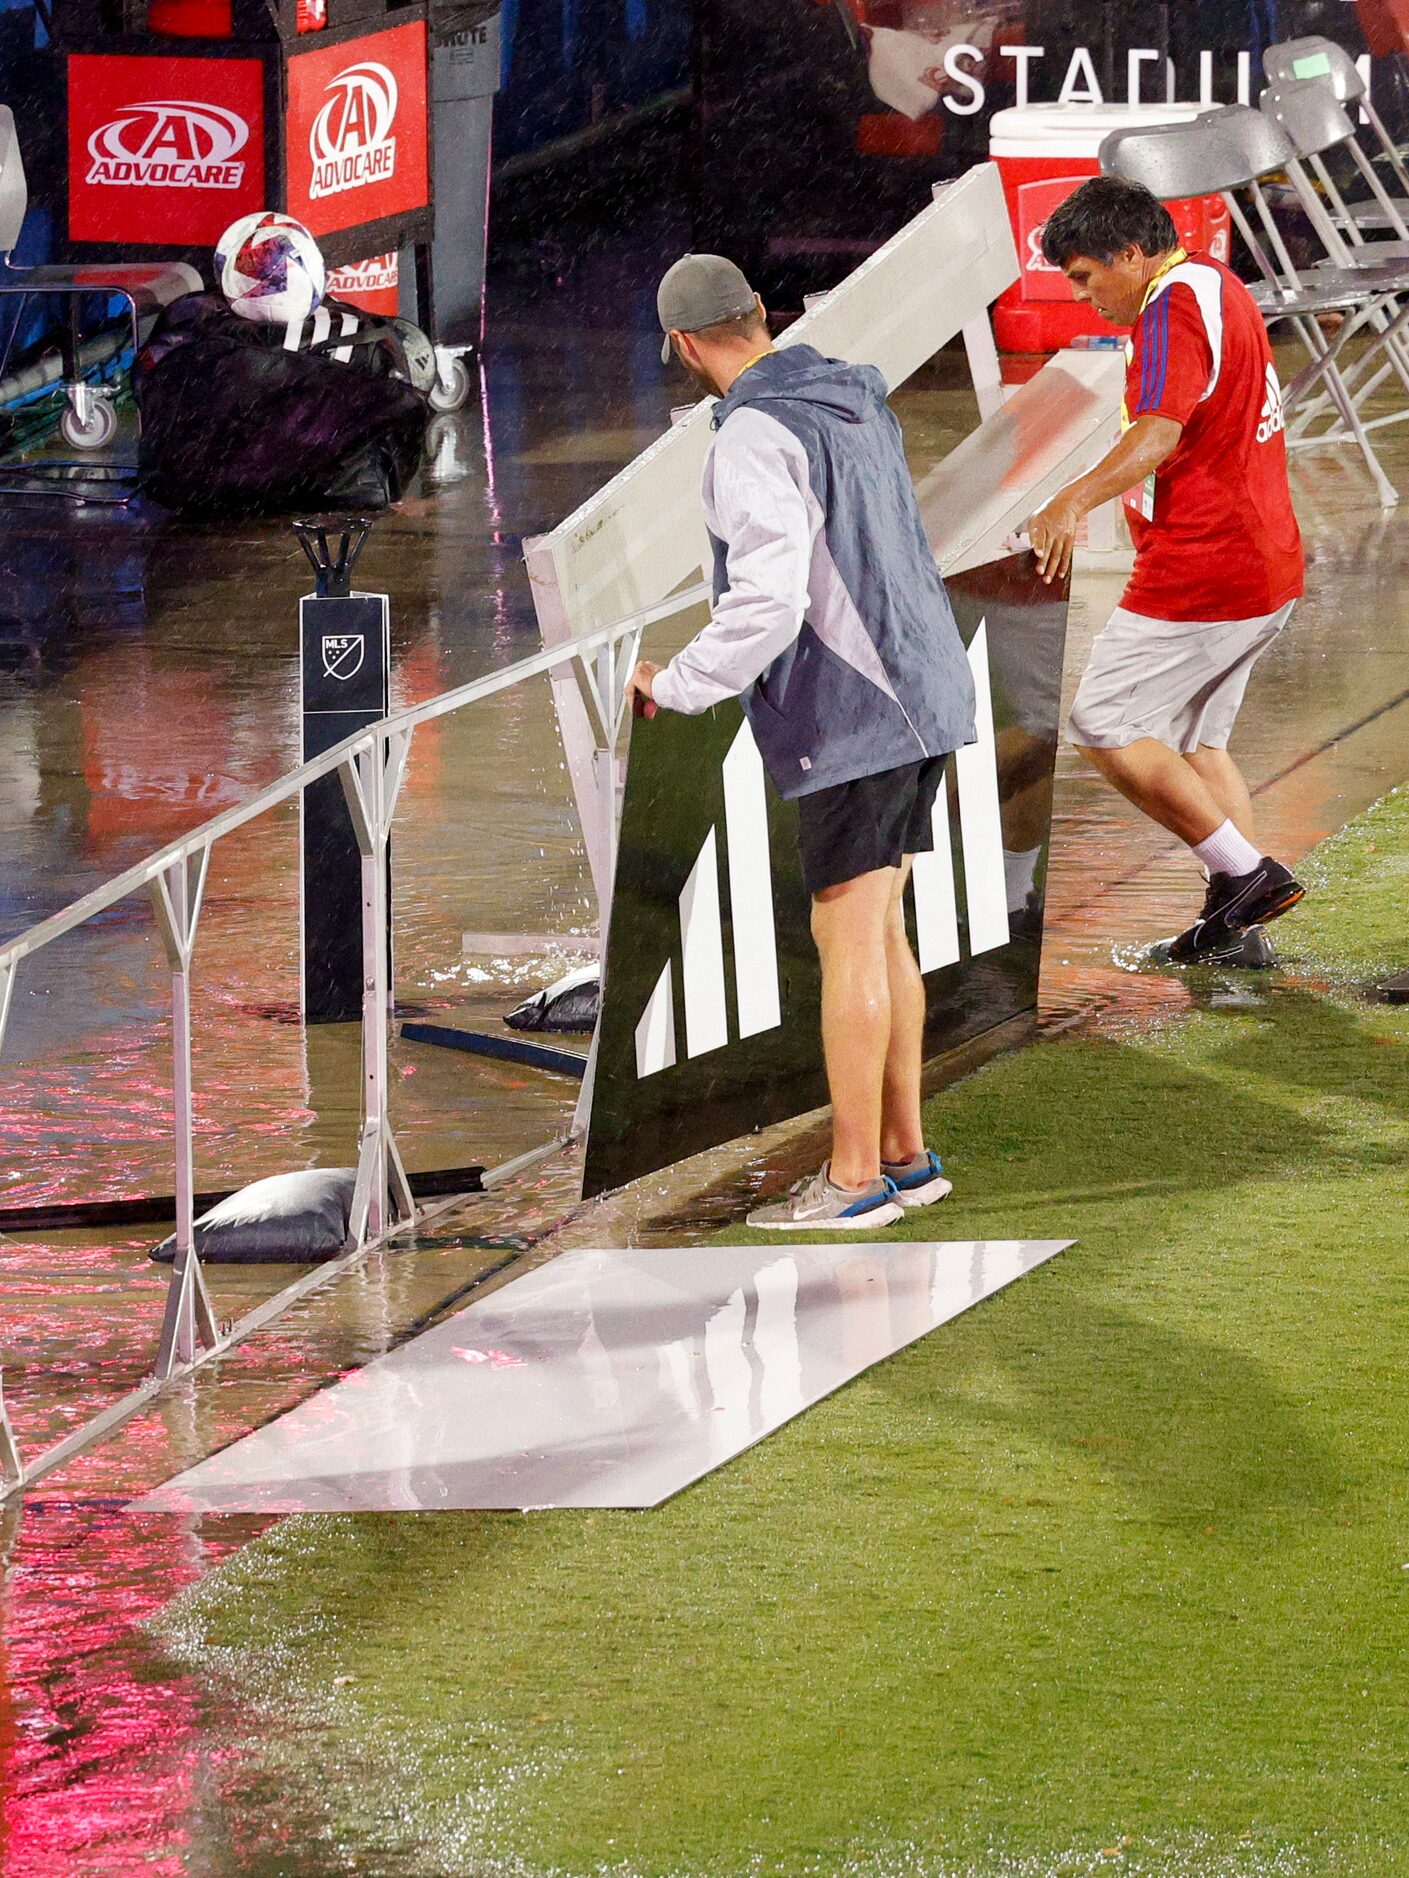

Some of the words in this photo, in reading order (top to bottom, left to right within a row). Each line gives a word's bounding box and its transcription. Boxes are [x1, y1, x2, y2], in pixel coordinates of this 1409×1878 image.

[90, 161, 241, 185] ADVOCARE
[312, 144, 393, 194] ADVOCARE
[325, 639, 348, 649] MLS
